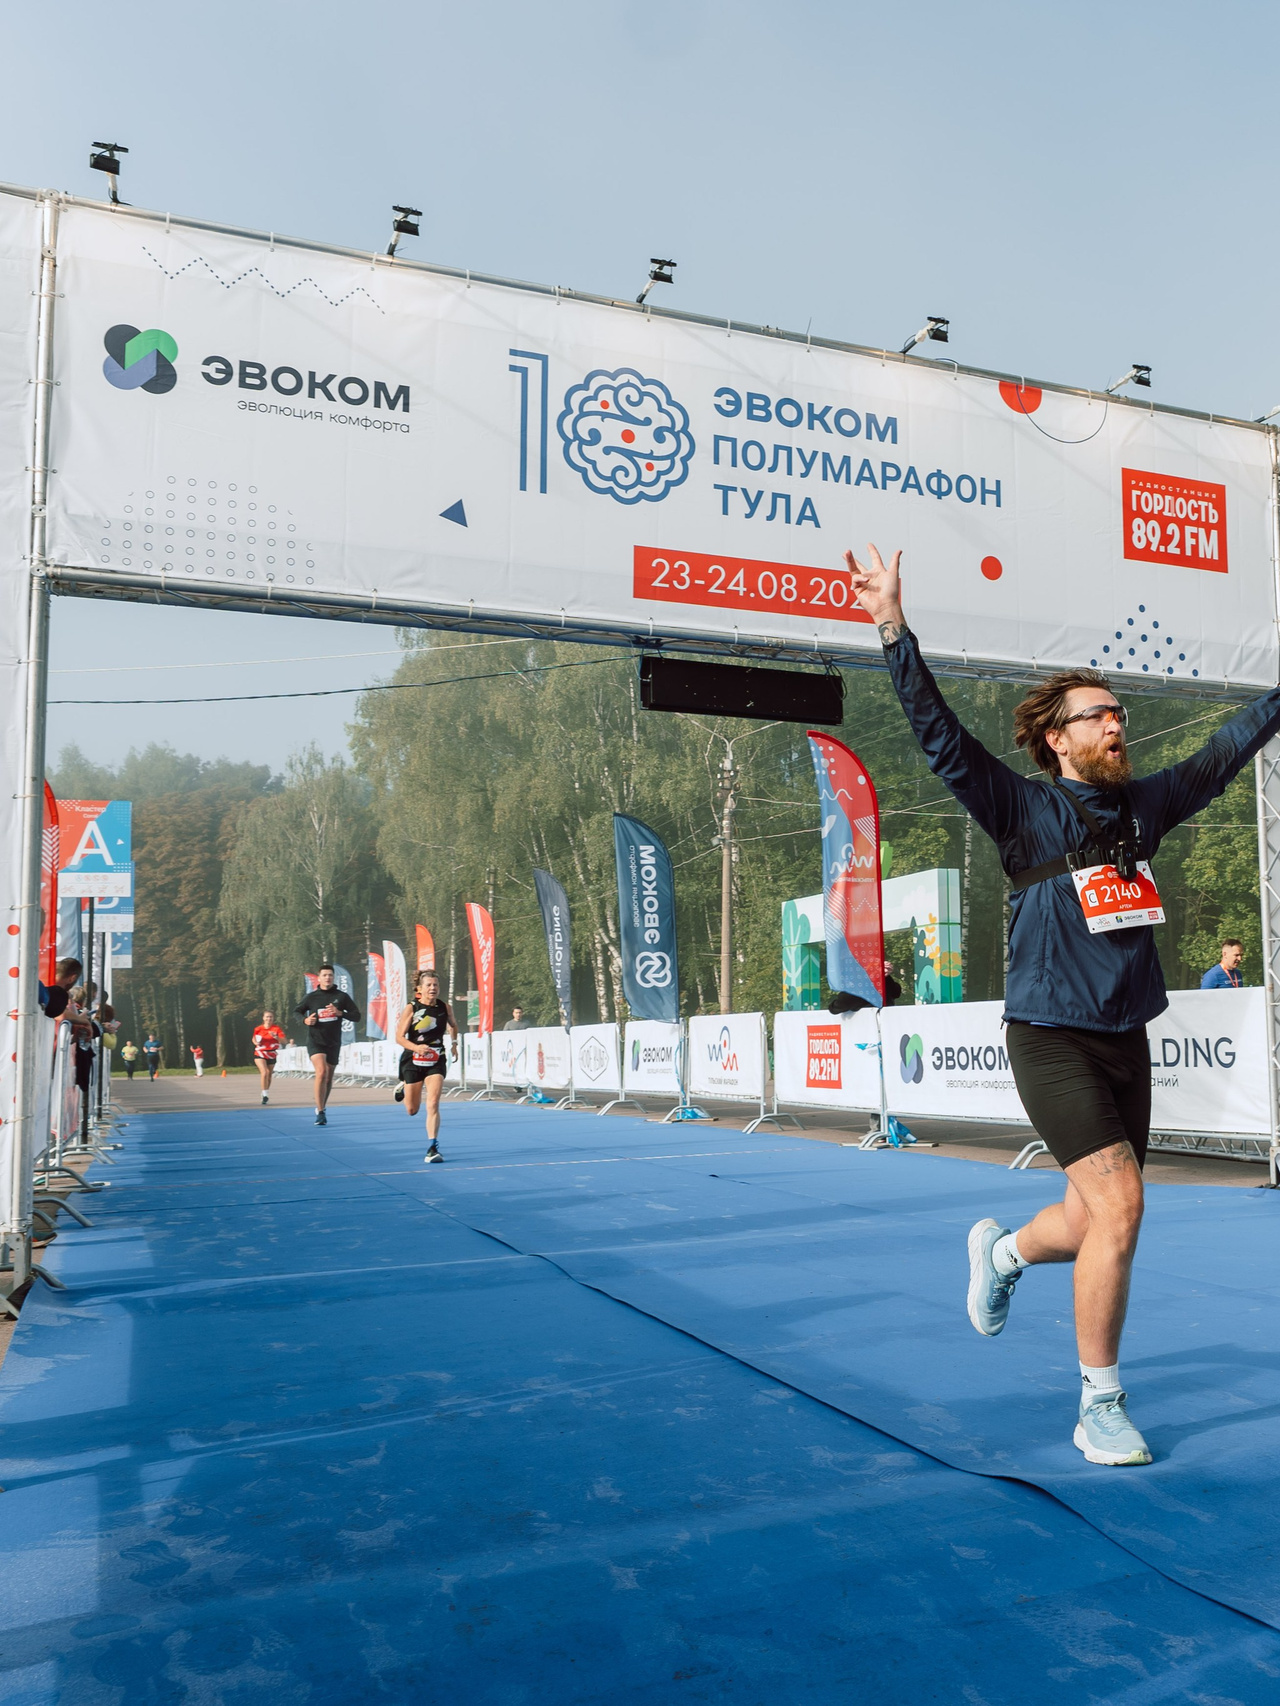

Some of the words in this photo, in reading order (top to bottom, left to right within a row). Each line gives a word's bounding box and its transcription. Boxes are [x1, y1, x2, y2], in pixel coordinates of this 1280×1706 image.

[201, 355, 410, 413] ЭВОКОМ
[237, 400, 323, 421] эволюция
[329, 412, 410, 433] комфорта
[713, 386, 898, 445] ЭВОКОМ
[713, 434, 1002, 508] ПОЛУМАРАФОН
[1131, 480, 1216, 498] РАДИОСТАНЦИЯ
[713, 483, 821, 529] ТУЛА
[1131, 489, 1218, 524] ГОРДОСТЬ
[1131, 517, 1180, 555] 89.2
[1184, 525, 1219, 560] FM
[651, 558, 865, 610] 23-24.08.20
[70, 820, 114, 865] A
[1100, 882, 1141, 903] 2140
[642, 1046, 673, 1063] ЭВОКОМ
[1147, 1036, 1236, 1068] LDING
[1151, 1074, 1179, 1087] аний
